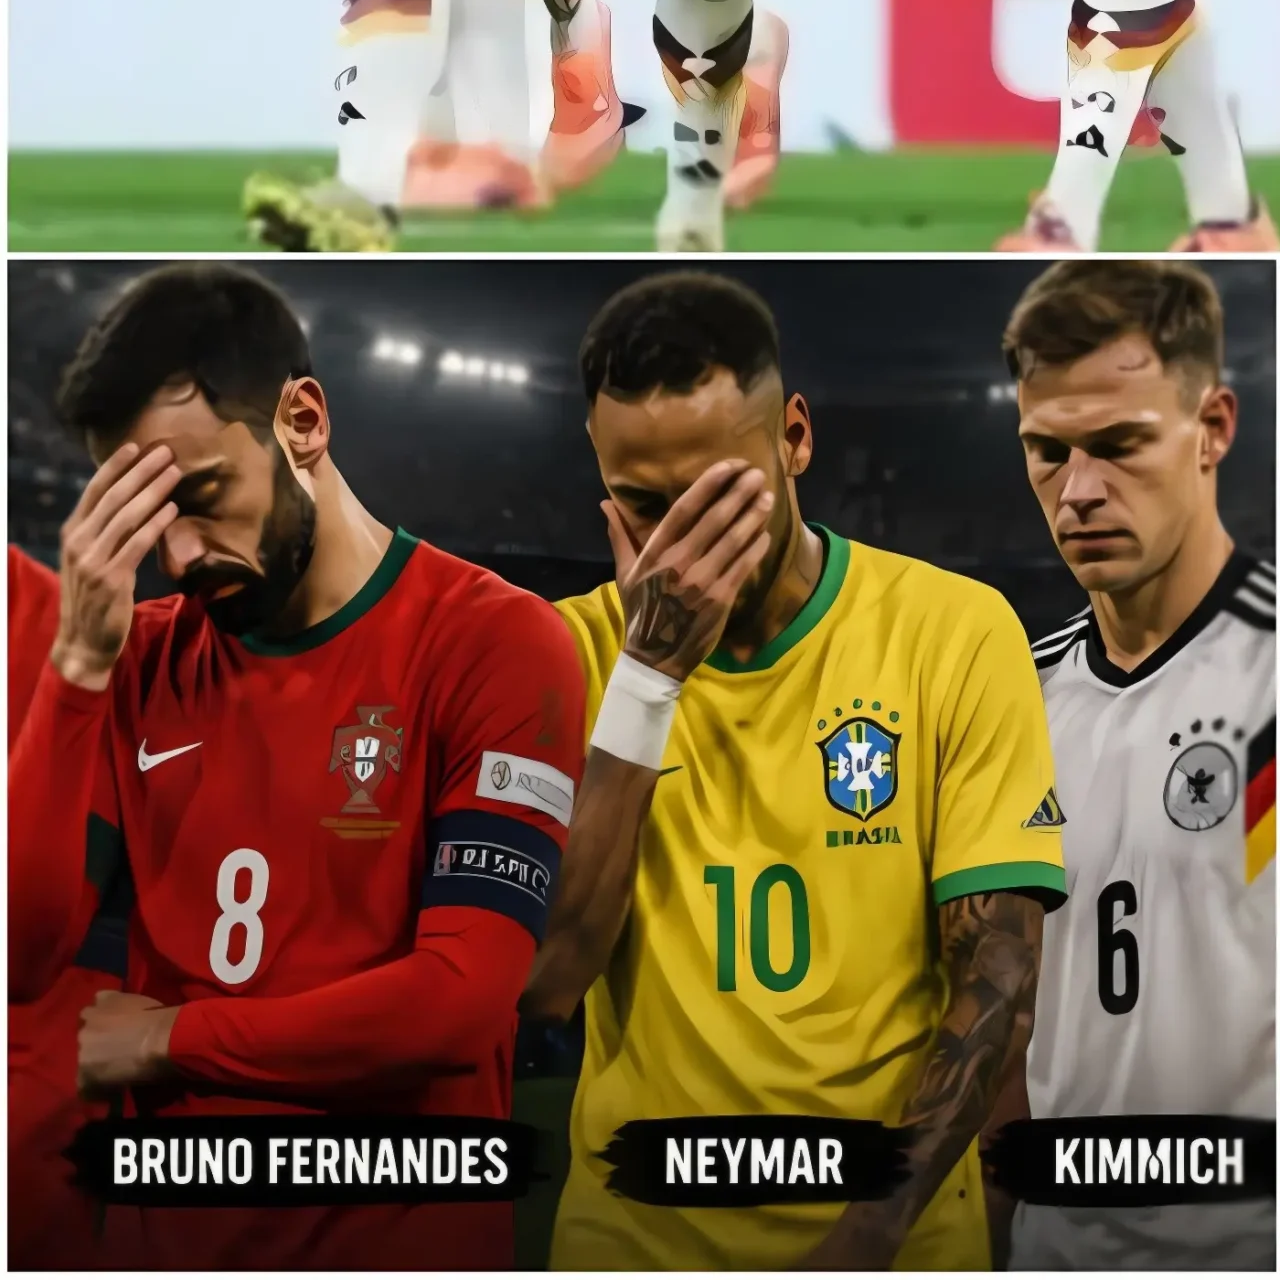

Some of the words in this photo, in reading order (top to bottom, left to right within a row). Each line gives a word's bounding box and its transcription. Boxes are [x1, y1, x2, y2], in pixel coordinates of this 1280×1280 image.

[209, 848, 270, 986] 8
[703, 862, 812, 993] 10
[1097, 879, 1140, 1016] 6
